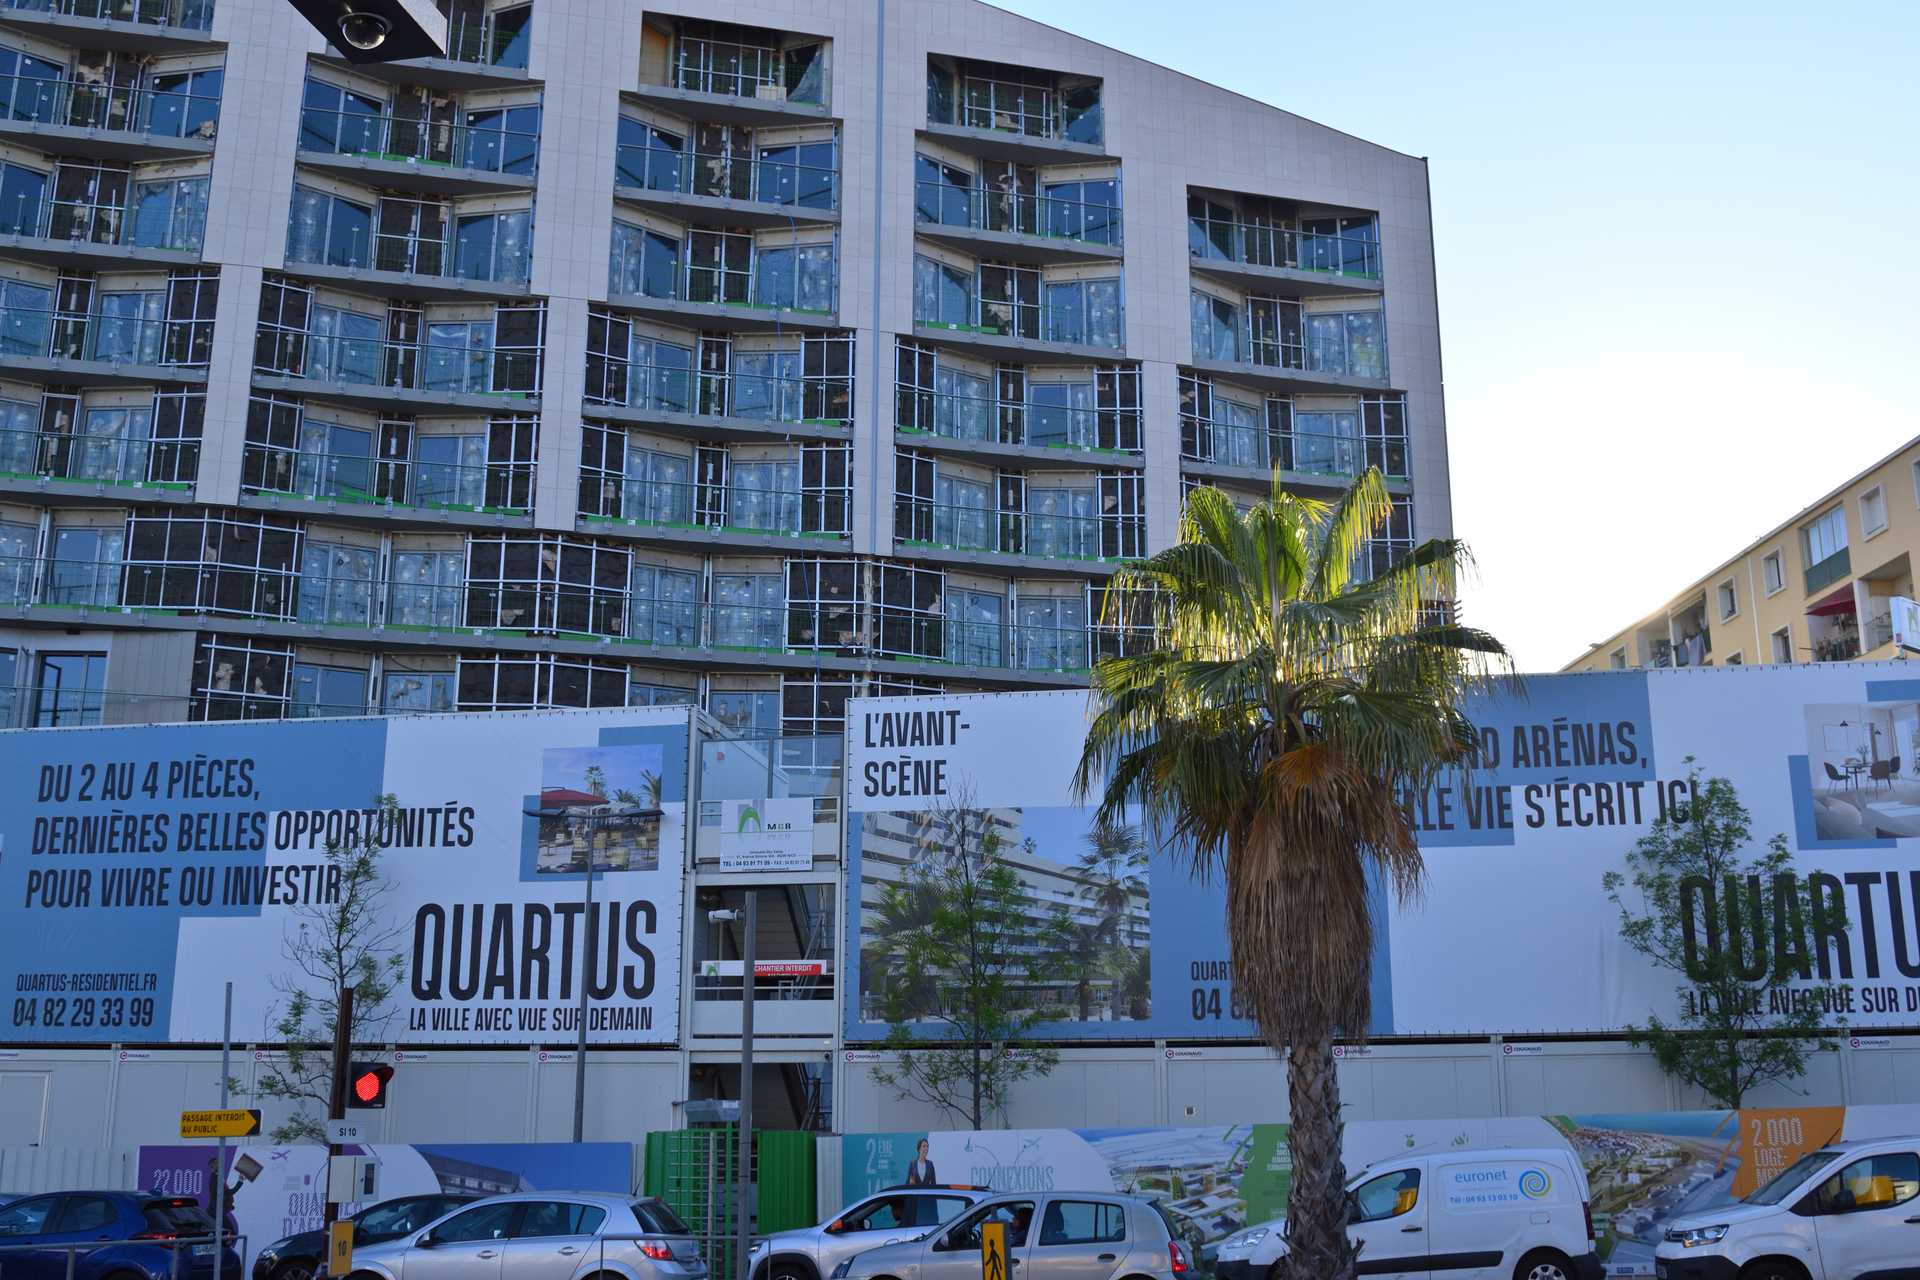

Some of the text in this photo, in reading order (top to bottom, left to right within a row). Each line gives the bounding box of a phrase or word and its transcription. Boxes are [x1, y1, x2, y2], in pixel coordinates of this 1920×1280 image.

[865, 710, 970, 748] L'AVANT-
[1513, 717, 1647, 769] ARÉNAS,
[38, 754, 260, 802] DU 2 AU 4 PIÈCES,
[864, 755, 947, 797] SCÈNE
[1463, 785, 1514, 830] VIE
[1525, 776, 1644, 828] S'ÉCRIT
[32, 801, 475, 855] DERNIÈRES BELLES OPPORTUNITÉS
[25, 864, 342, 908] POUR VIVRE OU INVESTIR
[411, 900, 657, 1001] QUARTUS
[16, 973, 157, 992] QUARTUS-RESIDENTIEL.FR
[13, 997, 154, 1026] 04 82 29 33 99
[1192, 988, 1222, 1020] 04
[1820, 987, 1856, 1014] VUE
[1861, 986, 1900, 1013] SUR
[410, 1006, 653, 1031] LA VILLE AVEC VUE SUR DEMAIN
[194, 1125, 218, 1133] PUBLIC
[215, 1112, 245, 1121] INTERDIT
[339, 1128, 357, 1136] SI 10
[1455, 1170, 1507, 1182] euronet
[338, 1240, 347, 1256] 10
